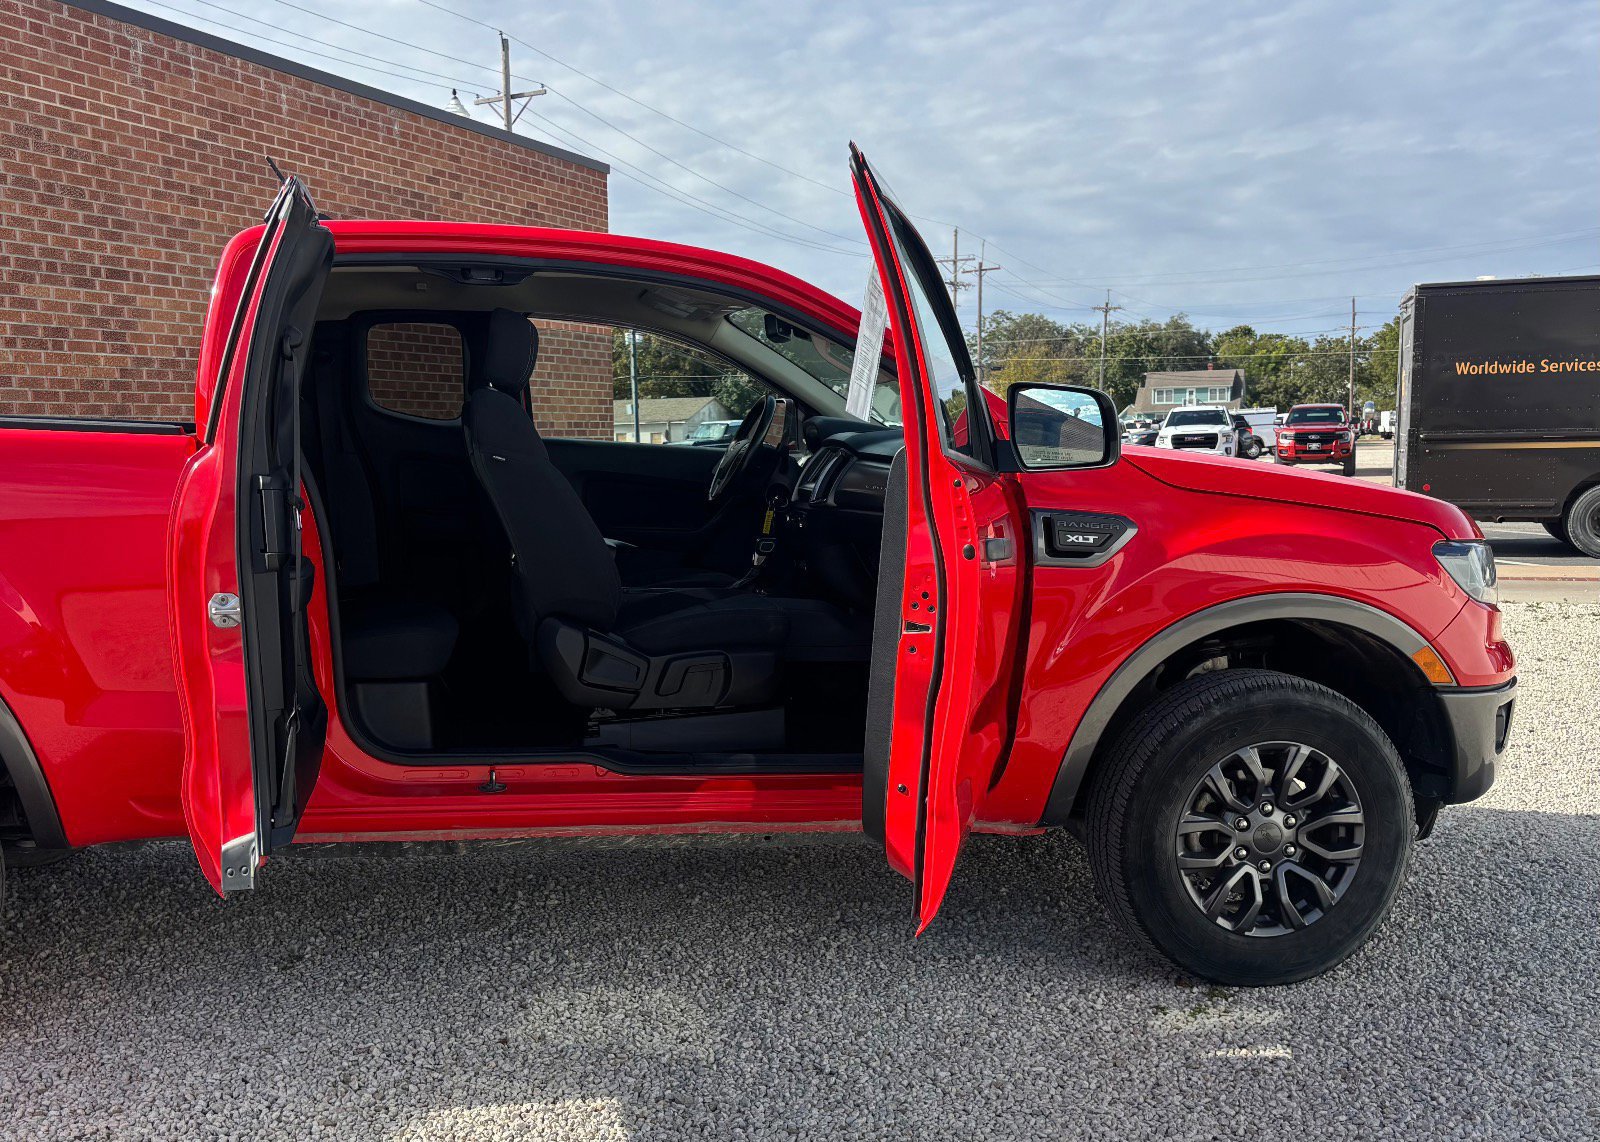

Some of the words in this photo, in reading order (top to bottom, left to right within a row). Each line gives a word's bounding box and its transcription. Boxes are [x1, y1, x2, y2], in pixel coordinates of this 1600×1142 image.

[1455, 360, 1535, 375] Worldwide
[1540, 358, 1600, 373] Services
[1056, 520, 1120, 530] RANGER
[1066, 534, 1099, 544] XLT
